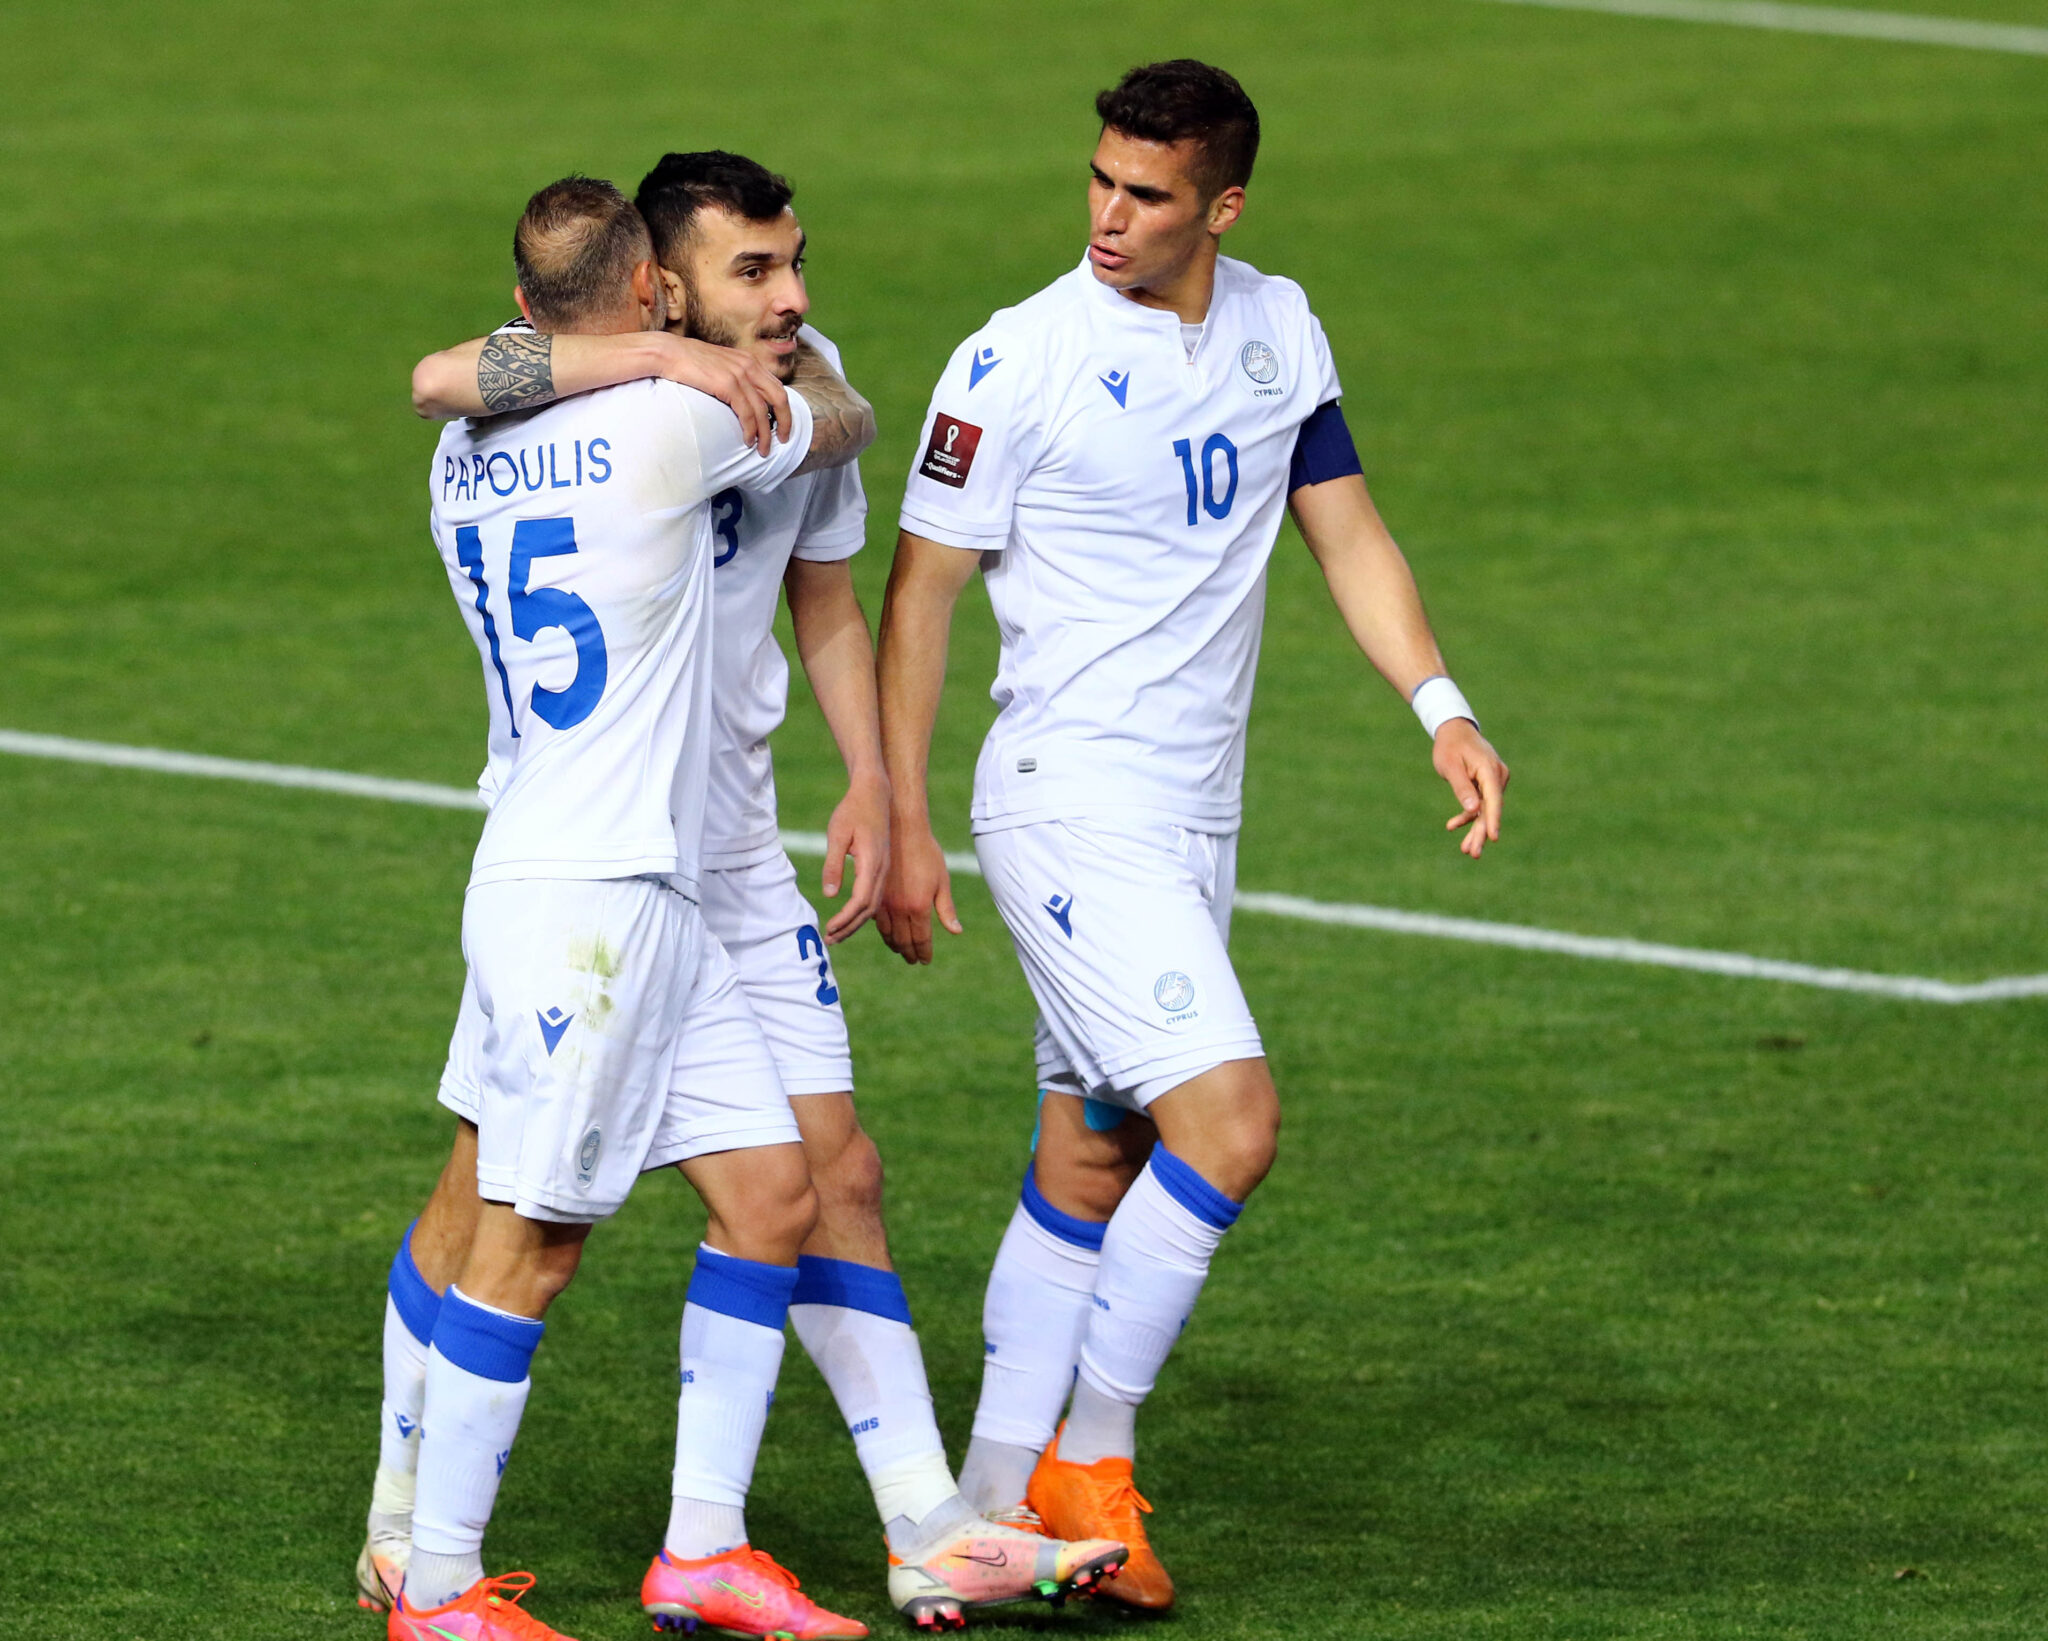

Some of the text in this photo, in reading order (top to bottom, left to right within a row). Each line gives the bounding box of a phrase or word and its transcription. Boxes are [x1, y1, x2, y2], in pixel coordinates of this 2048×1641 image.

[1254, 387, 1283, 397] CYPRUS
[443, 438, 612, 502] PAPOULIS
[1172, 433, 1238, 526] 10
[456, 517, 608, 738] 15
[1166, 1011, 1199, 1025] CYPRUS
[851, 1417, 879, 1435] RUS
